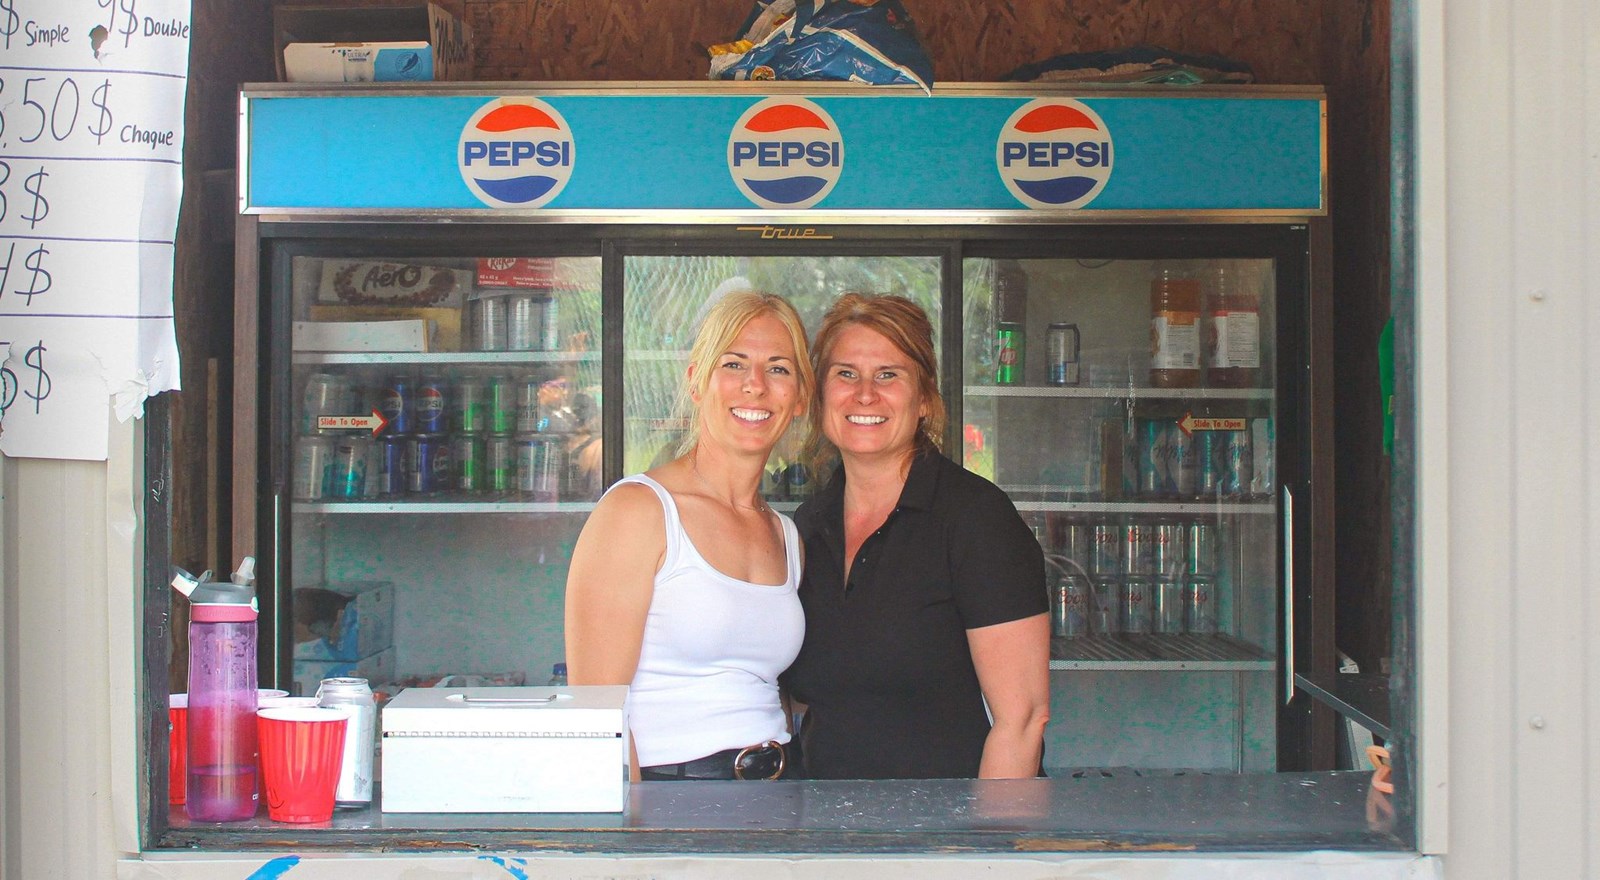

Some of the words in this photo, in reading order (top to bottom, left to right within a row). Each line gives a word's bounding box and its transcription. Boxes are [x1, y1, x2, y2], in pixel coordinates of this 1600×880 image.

[25, 21, 70, 47] Simple
[144, 17, 188, 38] Double
[120, 125, 173, 150] Chaque
[464, 141, 570, 167] PEPSI
[733, 141, 839, 167] PEPSI
[1003, 141, 1109, 168] PEPSI
[736, 225, 833, 239] true
[320, 418, 337, 426] Slide
[340, 418, 348, 426] To
[351, 418, 368, 427] Open
[1193, 420, 1210, 428] Slide
[1213, 420, 1221, 428] To
[1224, 420, 1241, 429] Open
